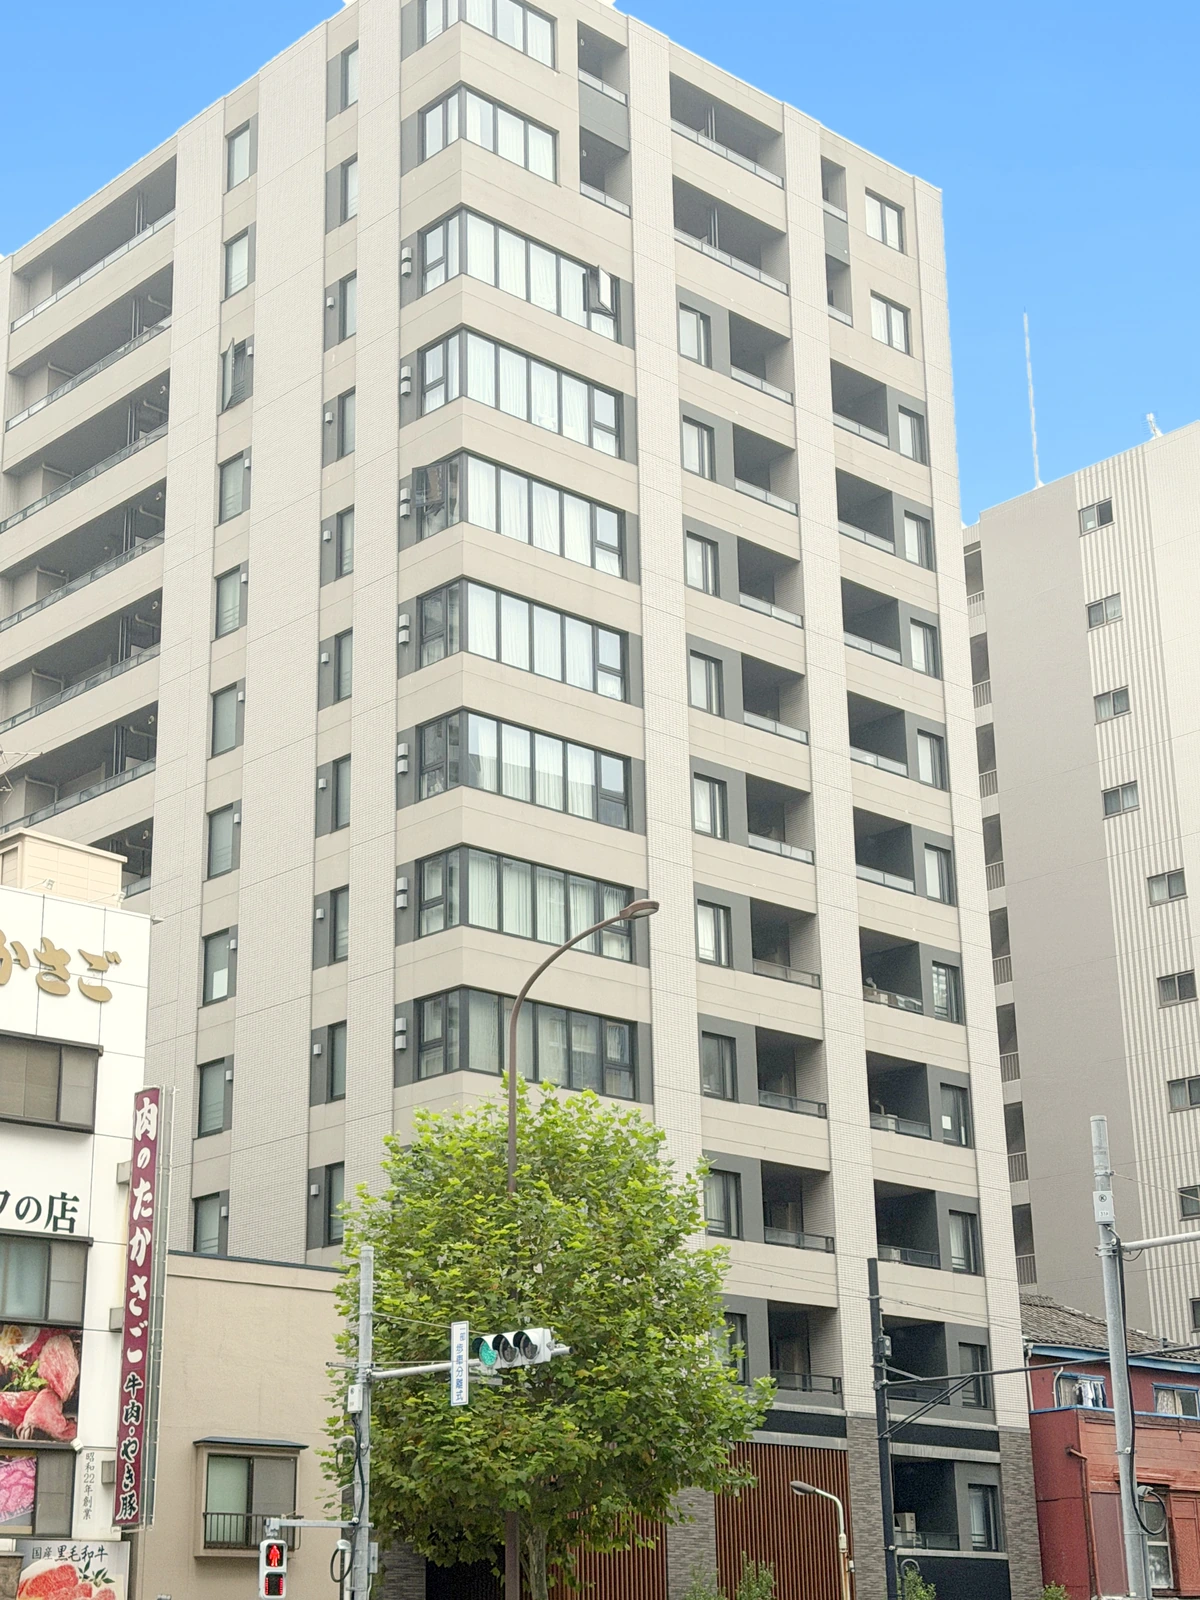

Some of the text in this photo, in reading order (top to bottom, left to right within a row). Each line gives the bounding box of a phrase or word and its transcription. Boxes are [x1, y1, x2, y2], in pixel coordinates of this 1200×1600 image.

[126, 1097, 158, 1363] 肉のたかさご
[83, 1452, 95, 1520] 昭和22年創業
